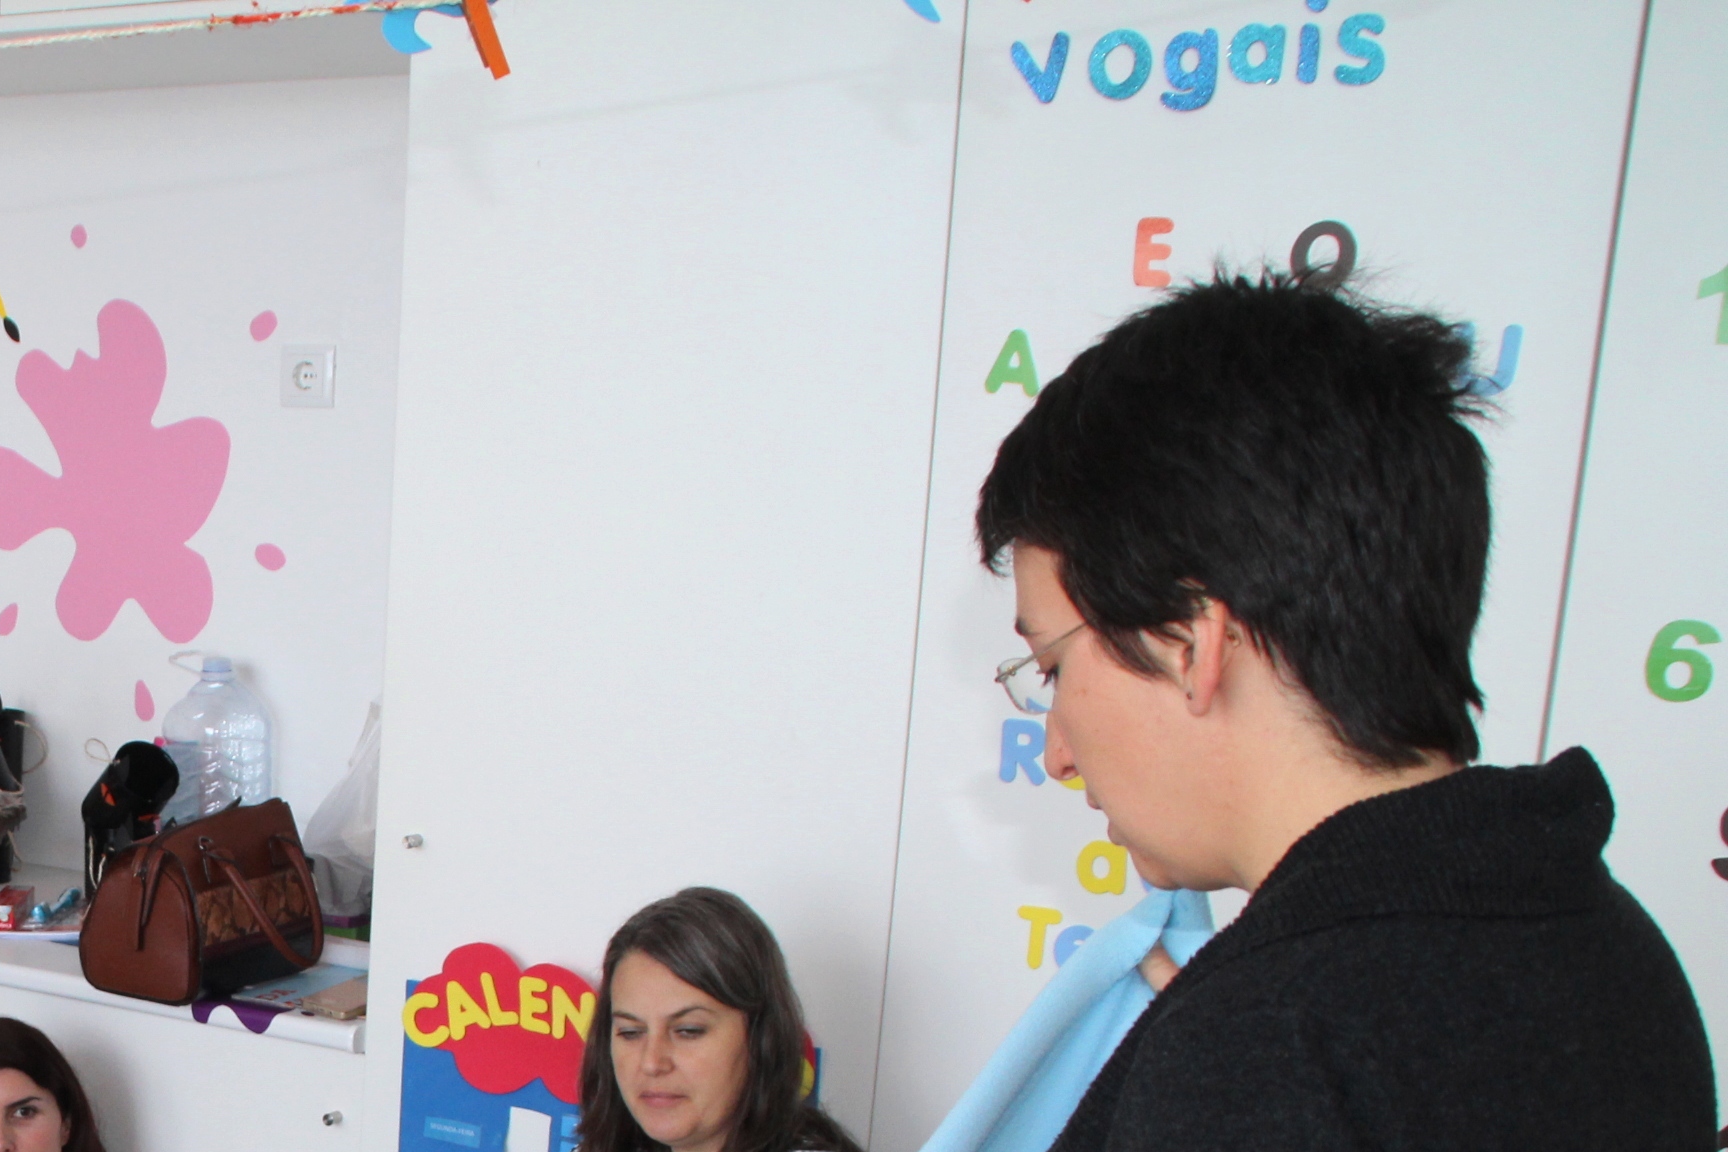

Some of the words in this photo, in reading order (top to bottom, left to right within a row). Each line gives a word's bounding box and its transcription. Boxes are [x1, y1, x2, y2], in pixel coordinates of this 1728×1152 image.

[1010, 0, 1386, 113] vogais
[1132, 216, 1175, 288] E
[983, 329, 1040, 398] A
[1643, 618, 1722, 703] 6
[401, 971, 597, 1048] CALEN
